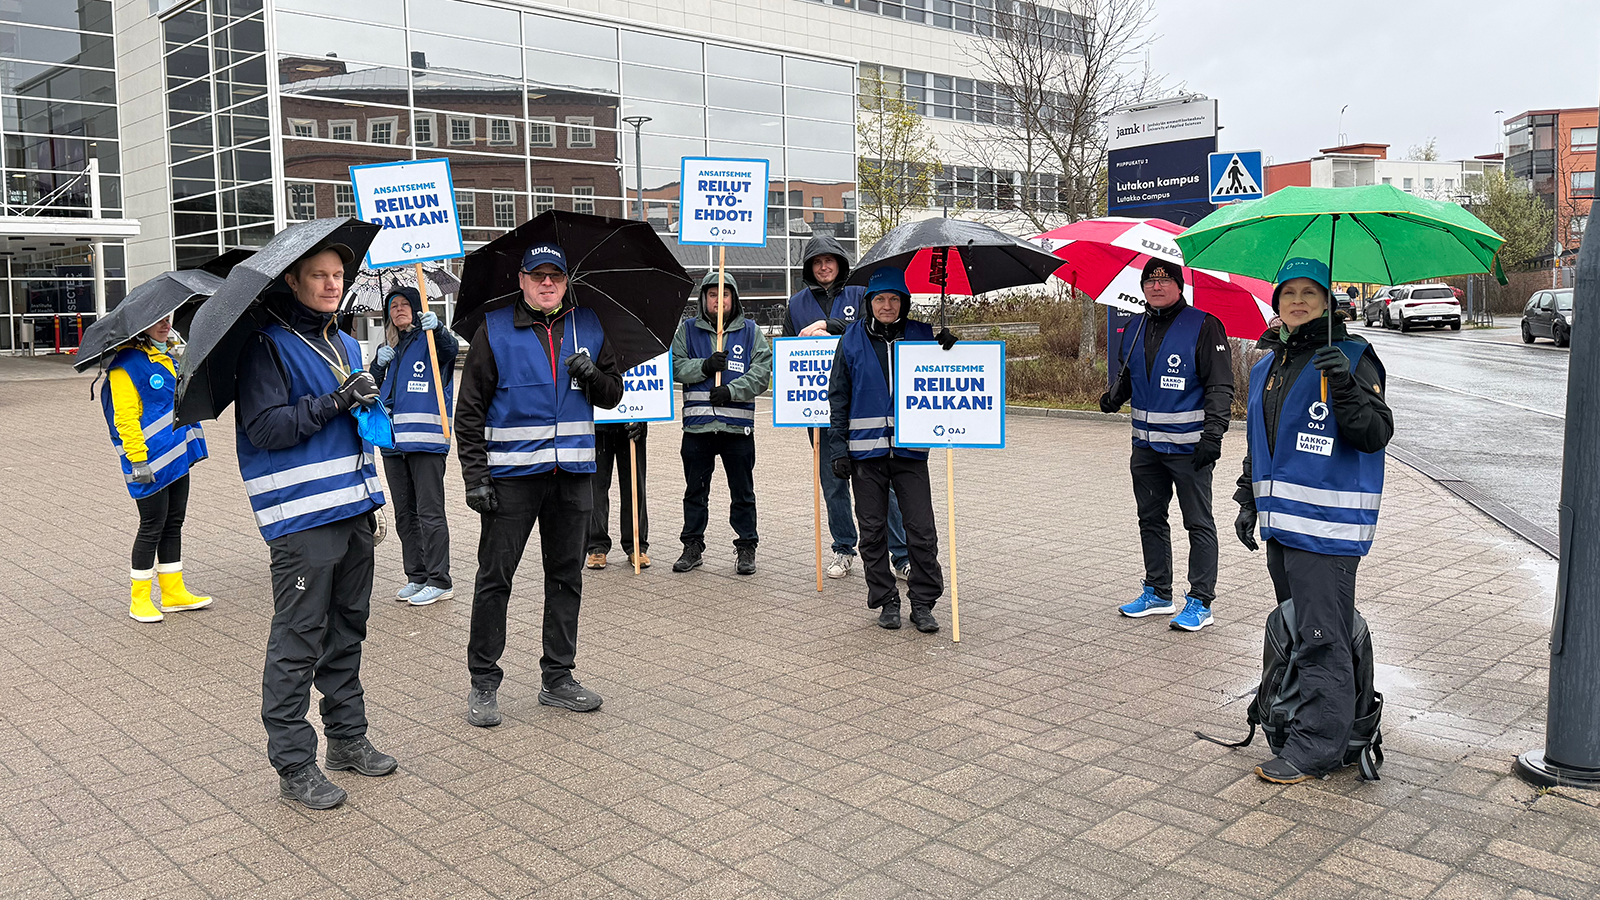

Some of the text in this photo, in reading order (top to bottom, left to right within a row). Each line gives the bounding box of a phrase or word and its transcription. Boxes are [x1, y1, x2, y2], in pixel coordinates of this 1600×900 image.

[1116, 123, 1140, 139] jamk
[698, 170, 752, 178] ANSAITSEMME
[373, 182, 436, 195] ANSAITSEMME
[698, 180, 752, 193] REILUT
[1117, 175, 1200, 191] Lutakon kampus
[374, 194, 439, 213] REILUN
[705, 192, 742, 207] TYÖ-
[1117, 192, 1171, 203] Lutakko Campus
[694, 208, 753, 222] EHDOT!
[414, 242, 431, 250] OAJ
[531, 246, 561, 258] Wilson
[789, 360, 832, 372] REILU
[914, 365, 984, 373] ANSAITSEMME
[913, 377, 985, 392] REILUN
[787, 389, 828, 402] EHDO
[906, 395, 993, 410] PALKAN!
[948, 427, 966, 435] OAJ
[1307, 421, 1325, 430] OAJ
[1300, 435, 1331, 446] LAKKO-
[1299, 442, 1323, 452] VAHTI
